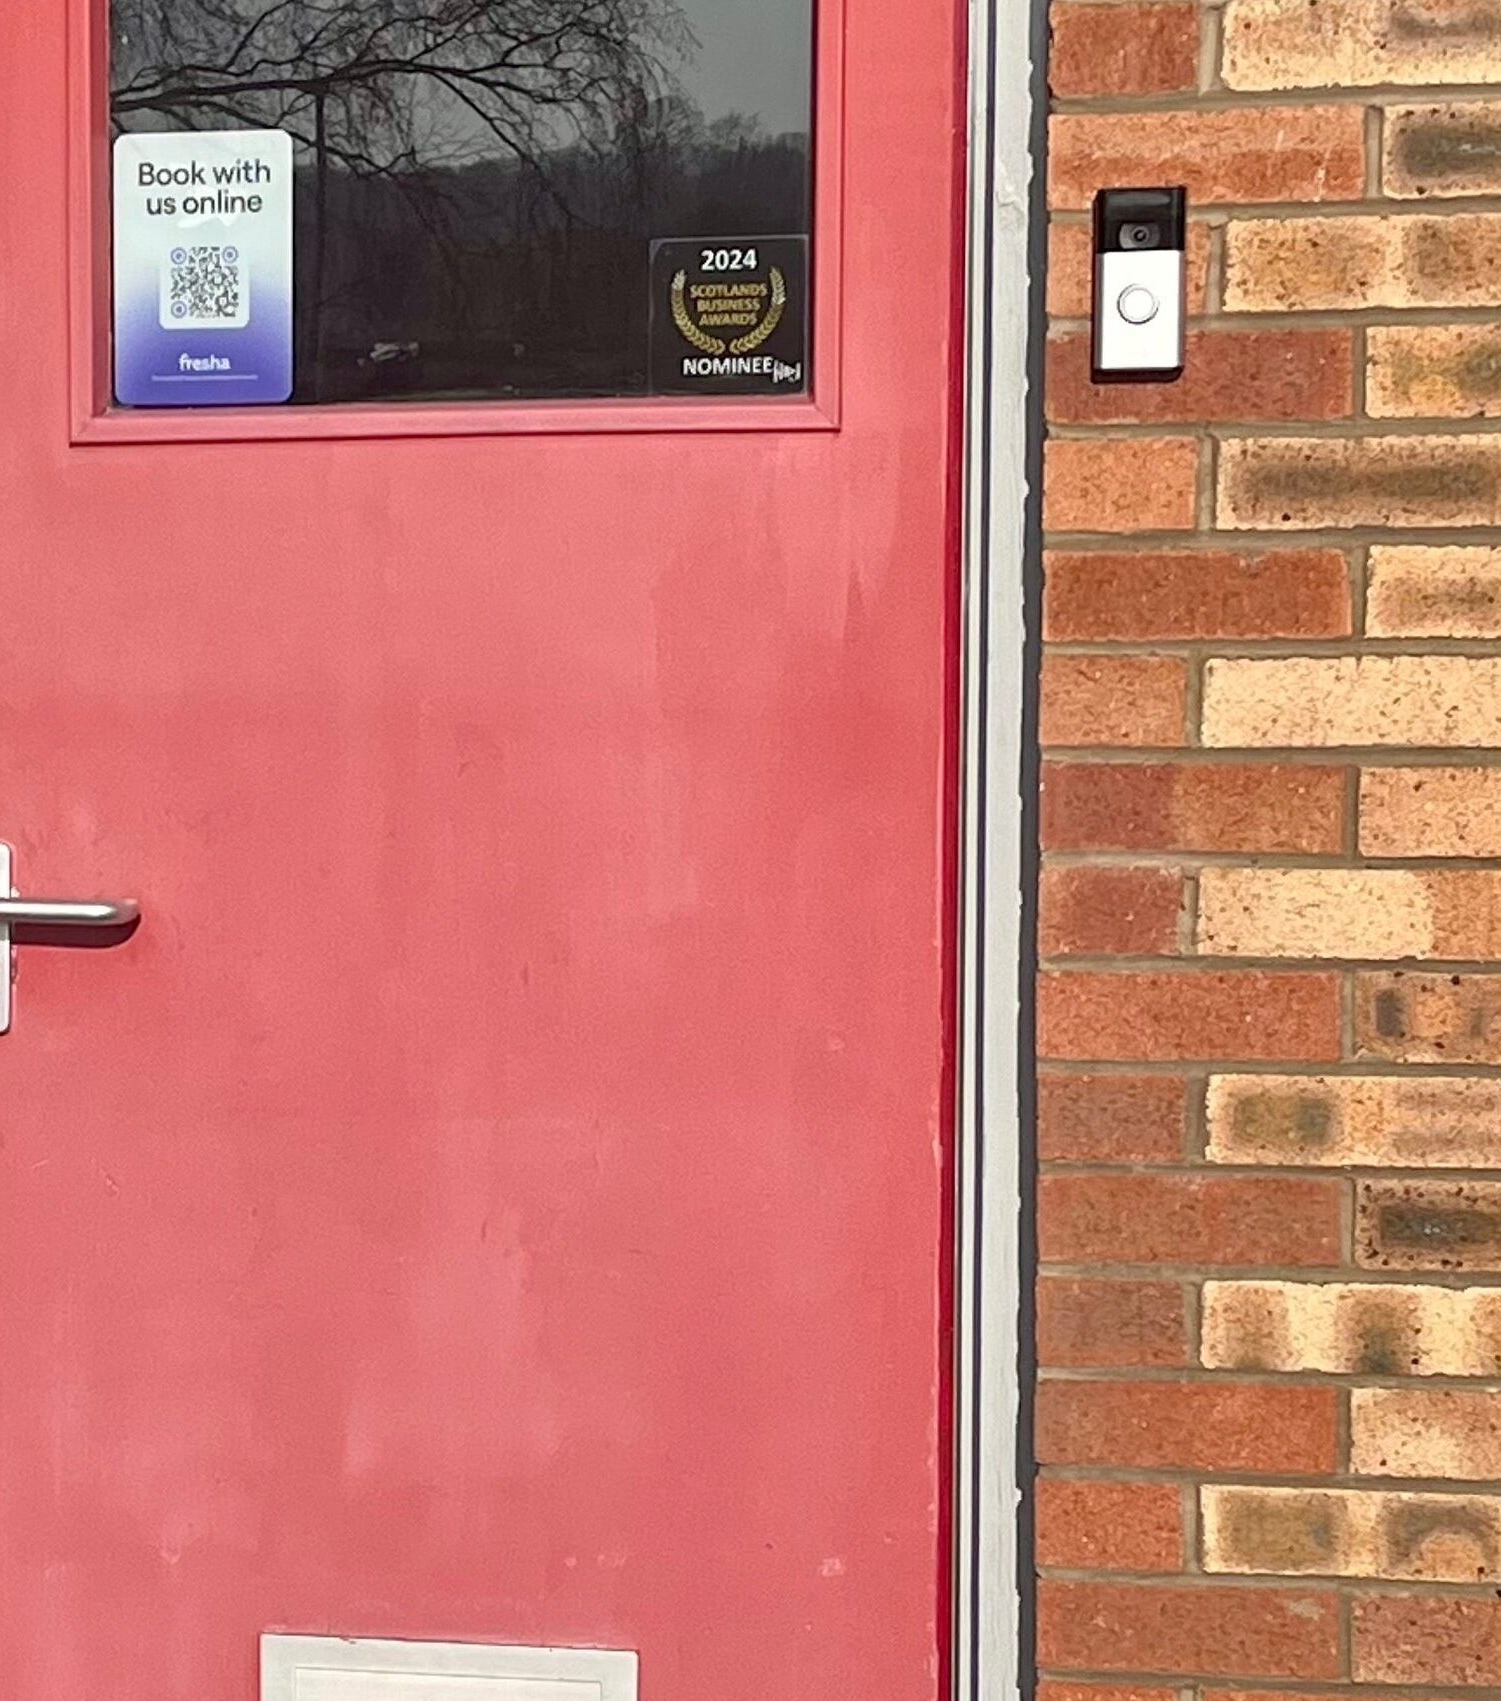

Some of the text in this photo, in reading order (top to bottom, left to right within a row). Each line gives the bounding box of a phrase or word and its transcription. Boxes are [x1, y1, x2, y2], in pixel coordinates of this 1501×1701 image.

[138, 158, 271, 187] Book with
[146, 189, 263, 215] us online
[700, 248, 758, 271] 2024
[689, 283, 768, 298] SCOTLANDS
[697, 298, 762, 312] BUSINESS
[698, 312, 759, 326] AWARDS
[178, 352, 232, 371] fresha
[682, 356, 773, 376] NOMINEE
